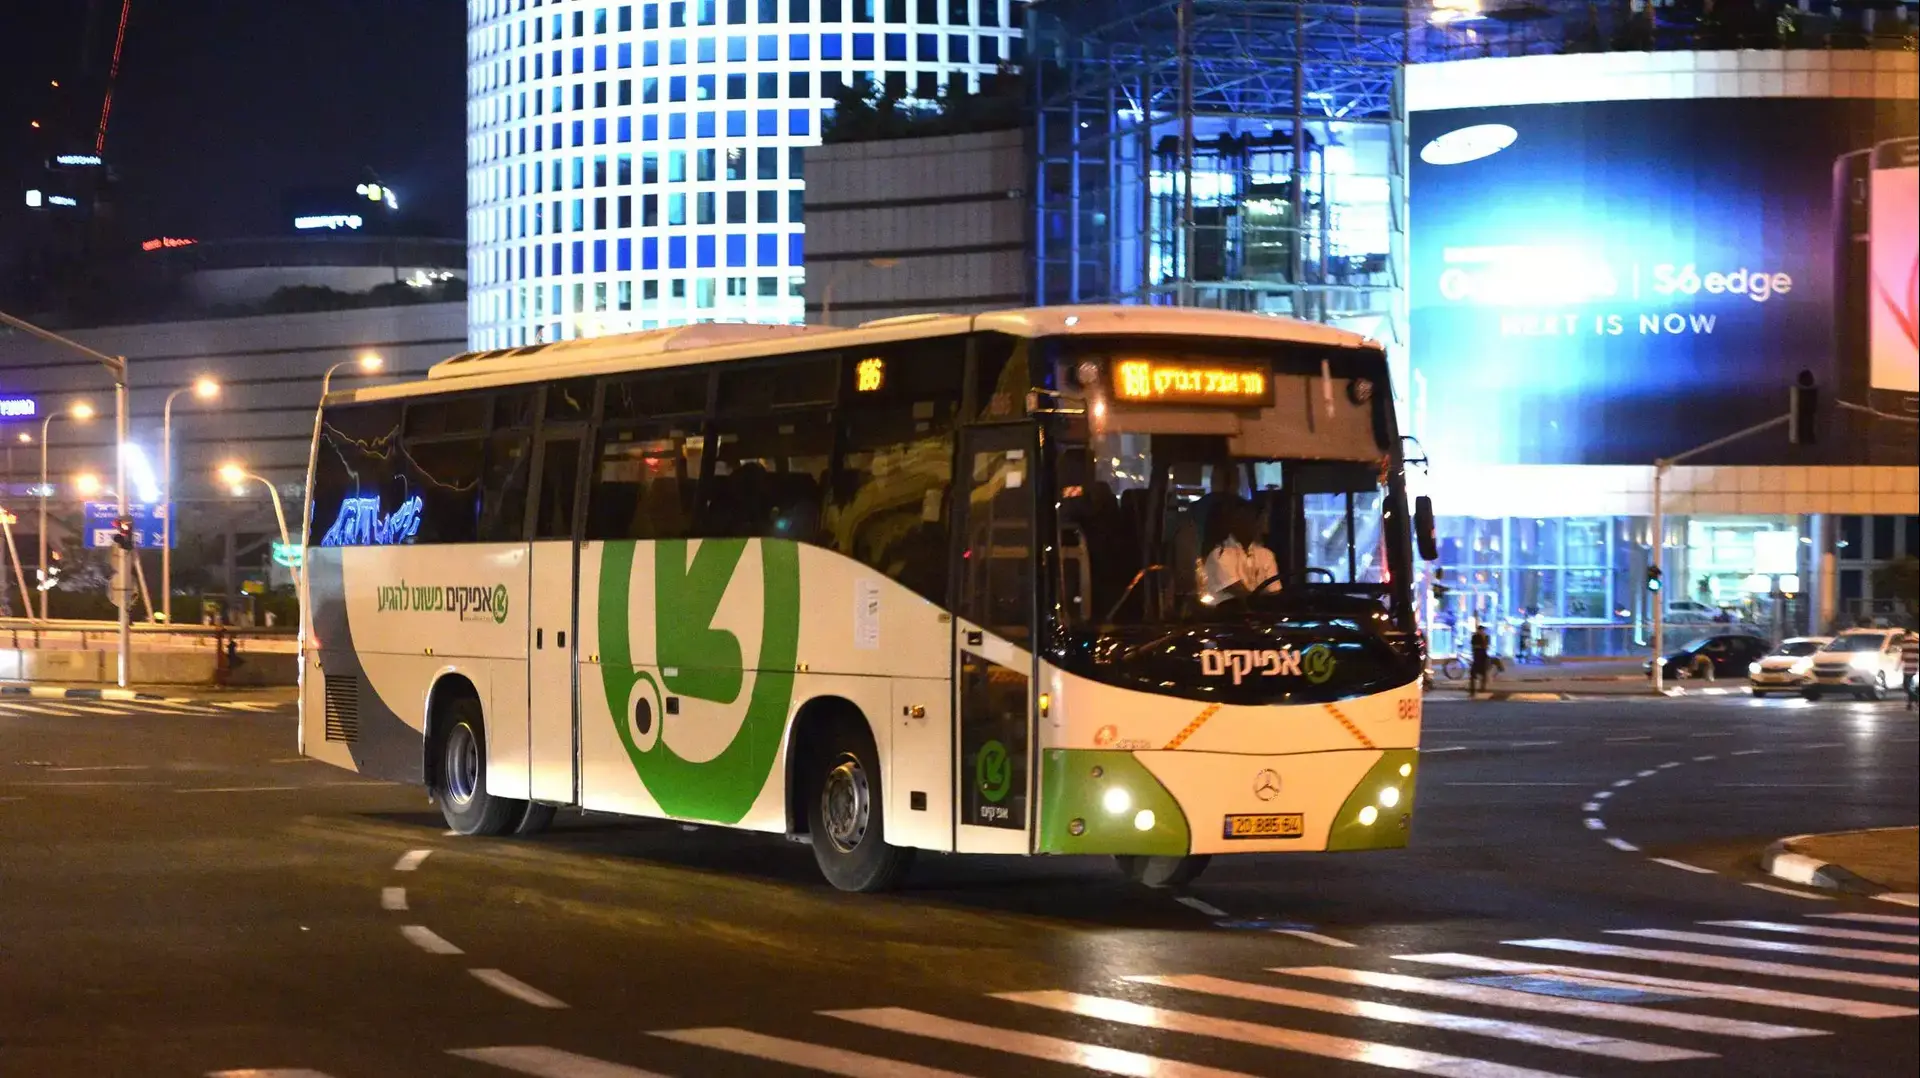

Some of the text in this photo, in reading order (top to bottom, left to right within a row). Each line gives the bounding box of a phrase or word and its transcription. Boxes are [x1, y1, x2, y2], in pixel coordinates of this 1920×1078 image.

[1703, 267, 1794, 302] edge
[1595, 313, 1624, 336] IS
[1638, 312, 1717, 335] NOW
[377, 578, 410, 612] להגיע
[412, 586, 444, 611] פשוט
[1202, 649, 1302, 685] אפיקים
